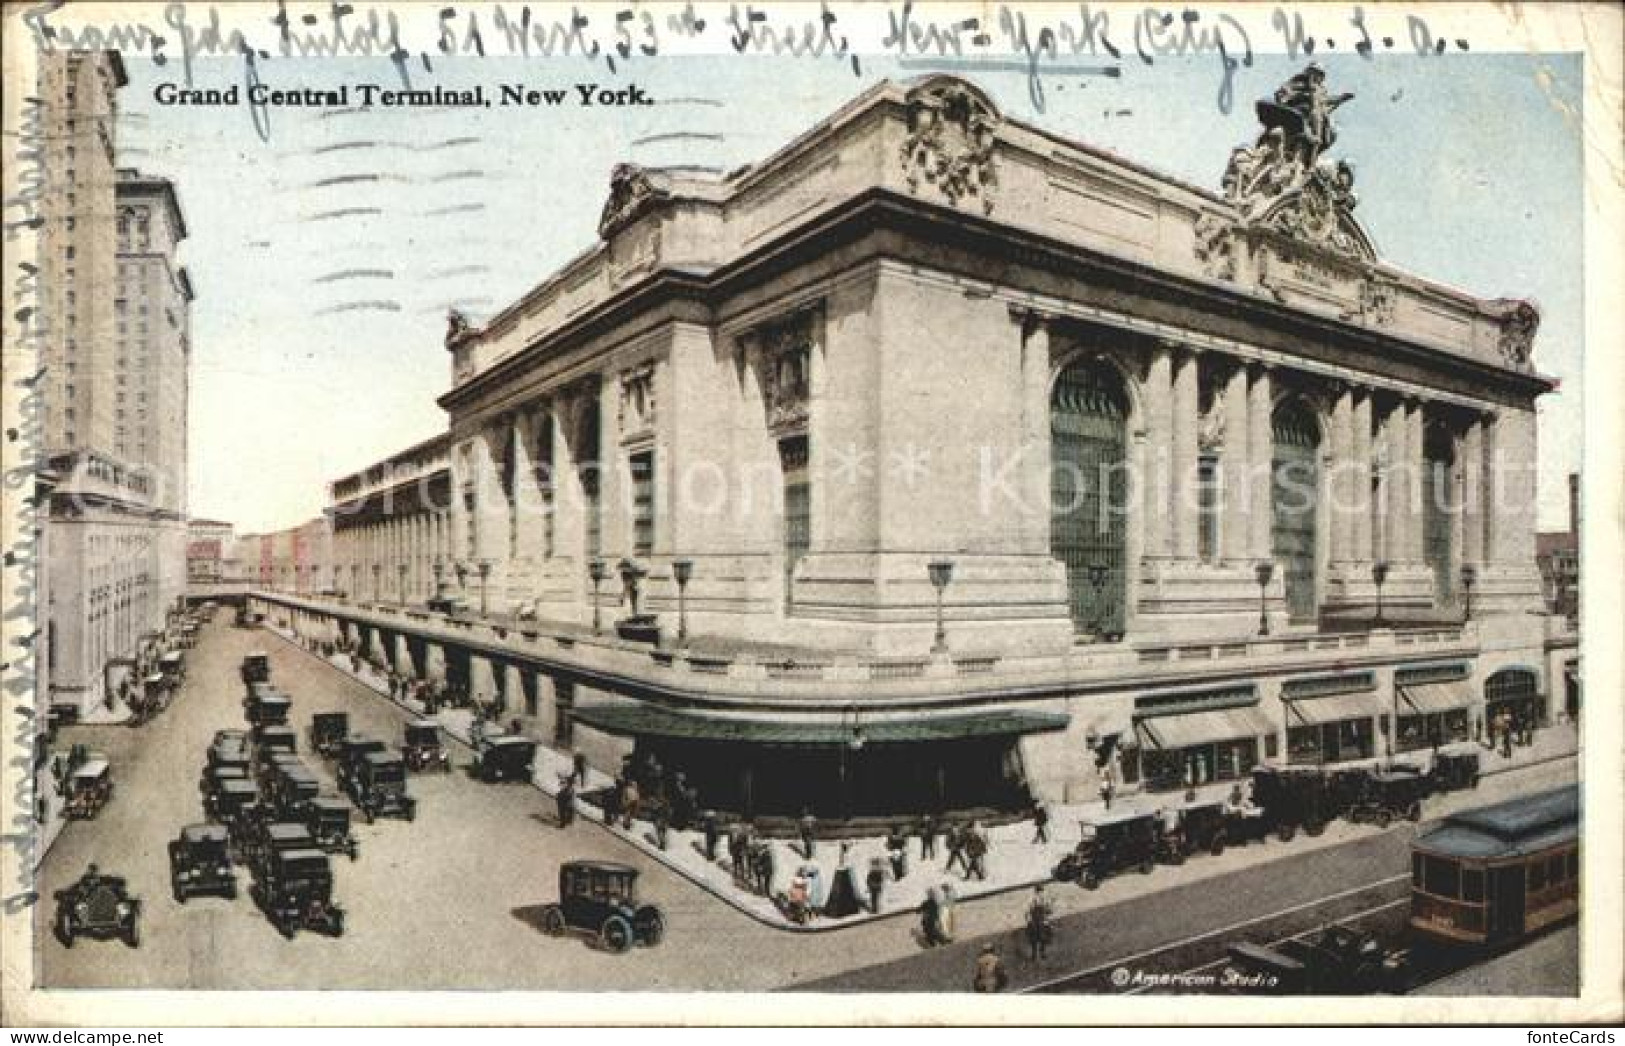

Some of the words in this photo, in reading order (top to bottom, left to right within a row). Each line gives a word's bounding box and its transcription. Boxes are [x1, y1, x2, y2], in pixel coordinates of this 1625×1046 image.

[154, 83, 239, 106] Grand
[248, 84, 349, 106] Central
[355, 84, 491, 108] Terminal,
[500, 84, 567, 106] New
[577, 84, 655, 106] York.
